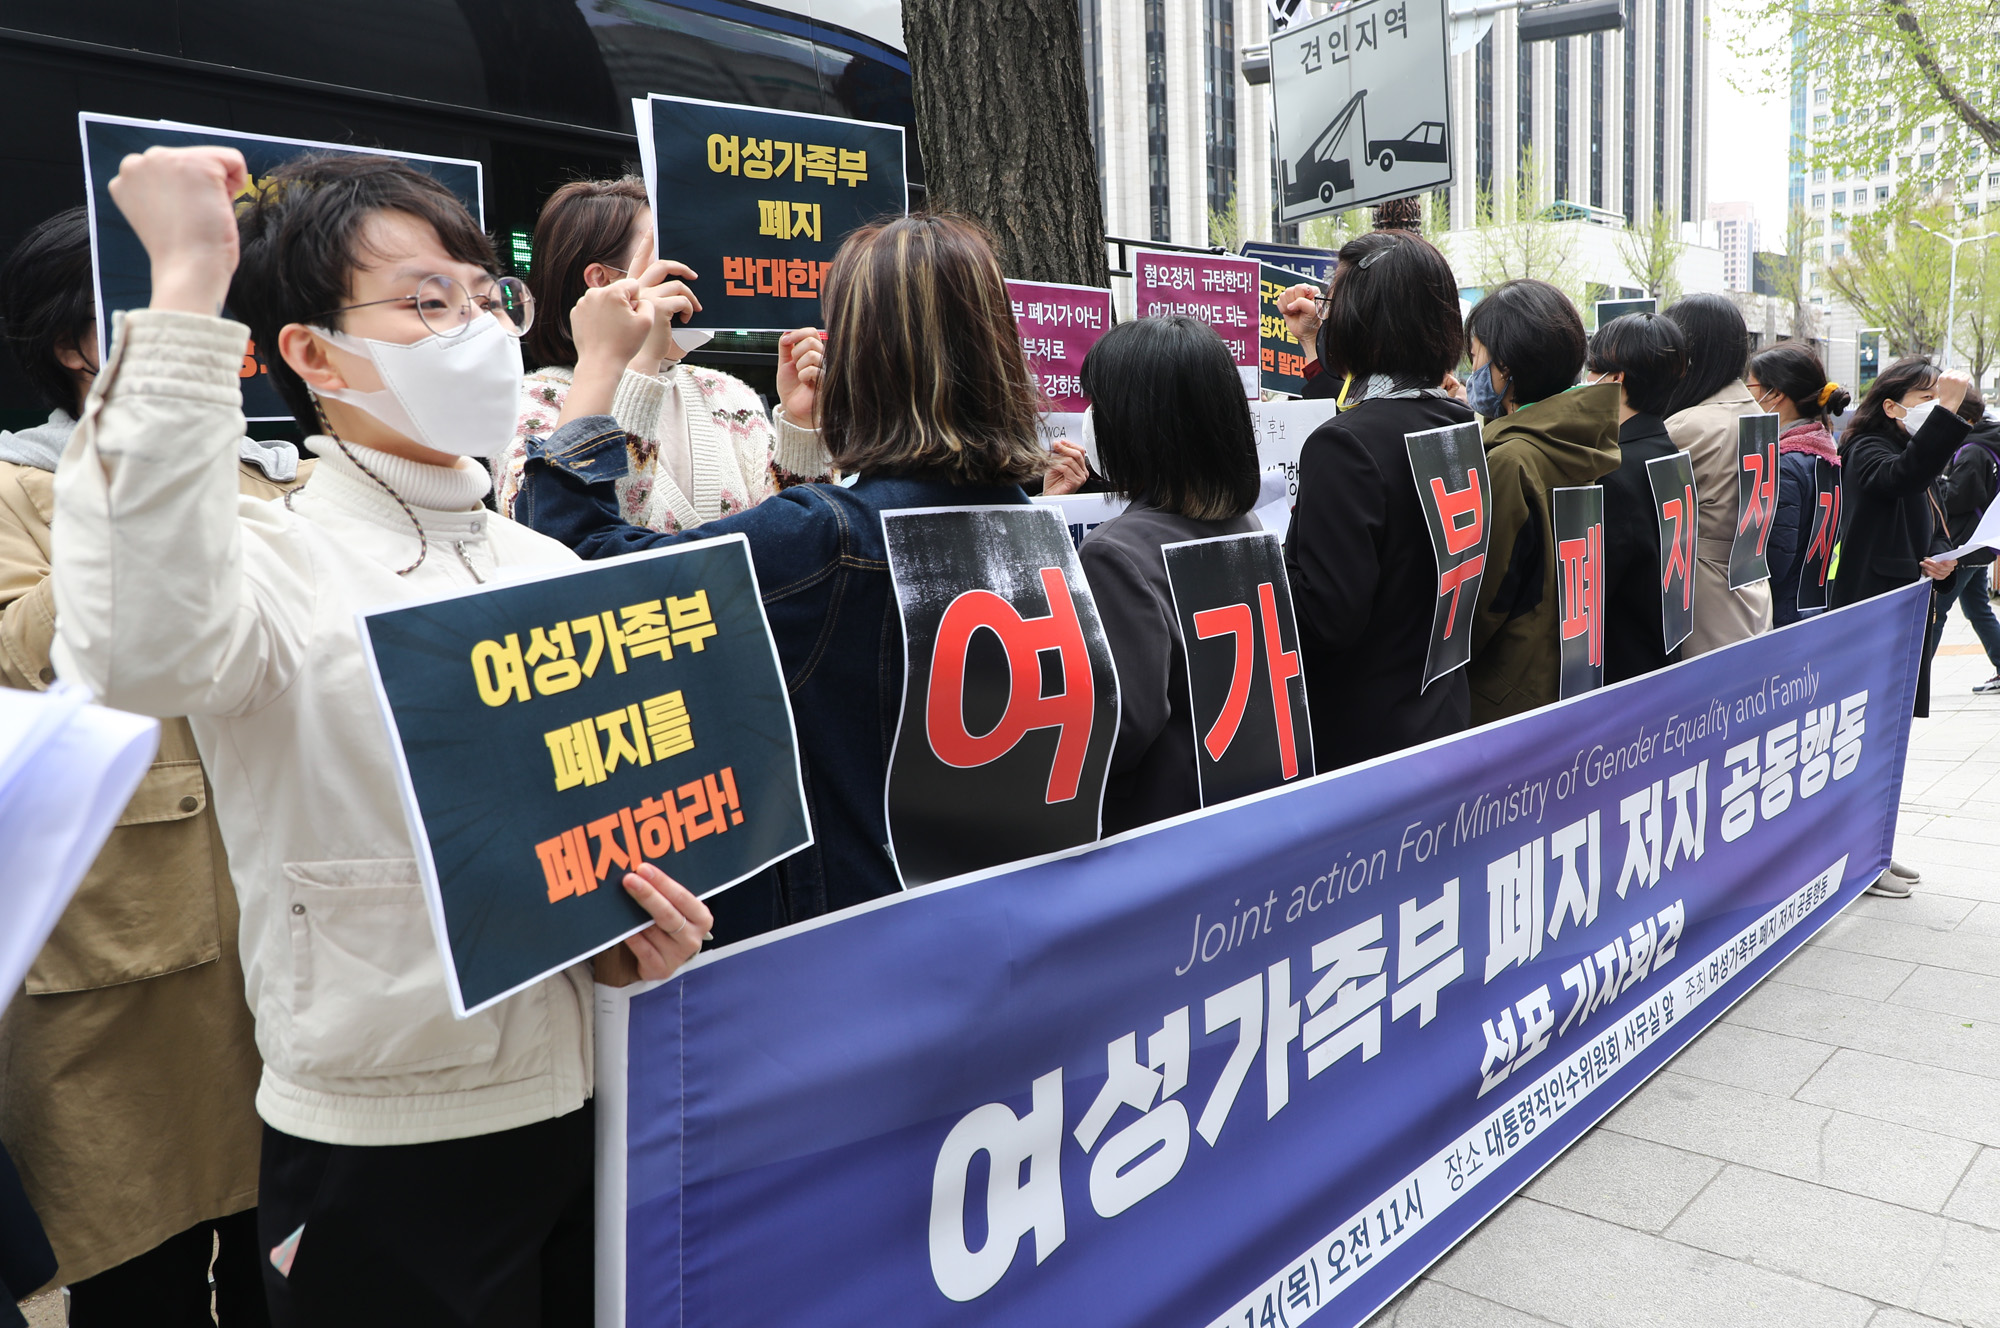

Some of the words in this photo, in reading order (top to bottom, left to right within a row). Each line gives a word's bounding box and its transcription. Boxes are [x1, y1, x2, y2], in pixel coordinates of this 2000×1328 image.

[1300, 4, 1408, 75] 견인지역
[706, 133, 868, 187] 여성가족부
[757, 199, 822, 242] 폐지
[1144, 264, 1195, 291] 혐오정치
[1201, 269, 1253, 293] 규탄한다!
[1011, 300, 1025, 324] 부
[1027, 301, 1072, 327] 폐지가
[1074, 305, 1102, 329] 아닌
[1225, 304, 1248, 327] 되는
[1266, 416, 1286, 443] 후보
[1430, 467, 1485, 641] 부
[1663, 484, 1692, 612] 지
[1739, 442, 1775, 556] 저
[1806, 484, 1840, 587] 지
[470, 589, 719, 708] 여성가족부
[1558, 522, 1602, 668] 폐
[543, 689, 696, 792] 폐지를
[926, 566, 1095, 805] 여
[1193, 582, 1300, 781] 가
[534, 766, 746, 905] 폐지하라!
[1174, 890, 1278, 977] Joint
[1285, 851, 1387, 923] action
[1396, 820, 1447, 873] For
[1453, 777, 1551, 847] Ministry
[1556, 749, 1584, 801] of
[1585, 726, 1661, 788] Gender
[1663, 698, 1731, 756] Equality
[1735, 677, 1767, 724] and
[1770, 662, 1820, 710] Family
[928, 877, 1465, 1302] 여성가족부
[1484, 809, 1601, 985] 폐지
[1616, 759, 1709, 900] 저지
[1720, 689, 1869, 843] 공동행동
[1477, 984, 1555, 1100] 선포
[1558, 898, 1686, 1038] 기자회견
[1244, 1256, 1320, 1328] 14(목)
[1327, 1216, 1373, 1284] 오전
[1376, 1178, 1424, 1246] 11시
[1444, 1140, 1484, 1193] 장소
[1484, 1030, 1622, 1158] 대통령직인수위원회
[1624, 1001, 1661, 1053] 사무실
[1662, 990, 1675, 1026] 앞
[1685, 966, 1706, 1006] 주최
[1709, 929, 1758, 985] 여성가족부
[1758, 911, 1777, 945] 폐지
[1778, 897, 1796, 930] 저지
[1797, 874, 1829, 918] 공동행동
